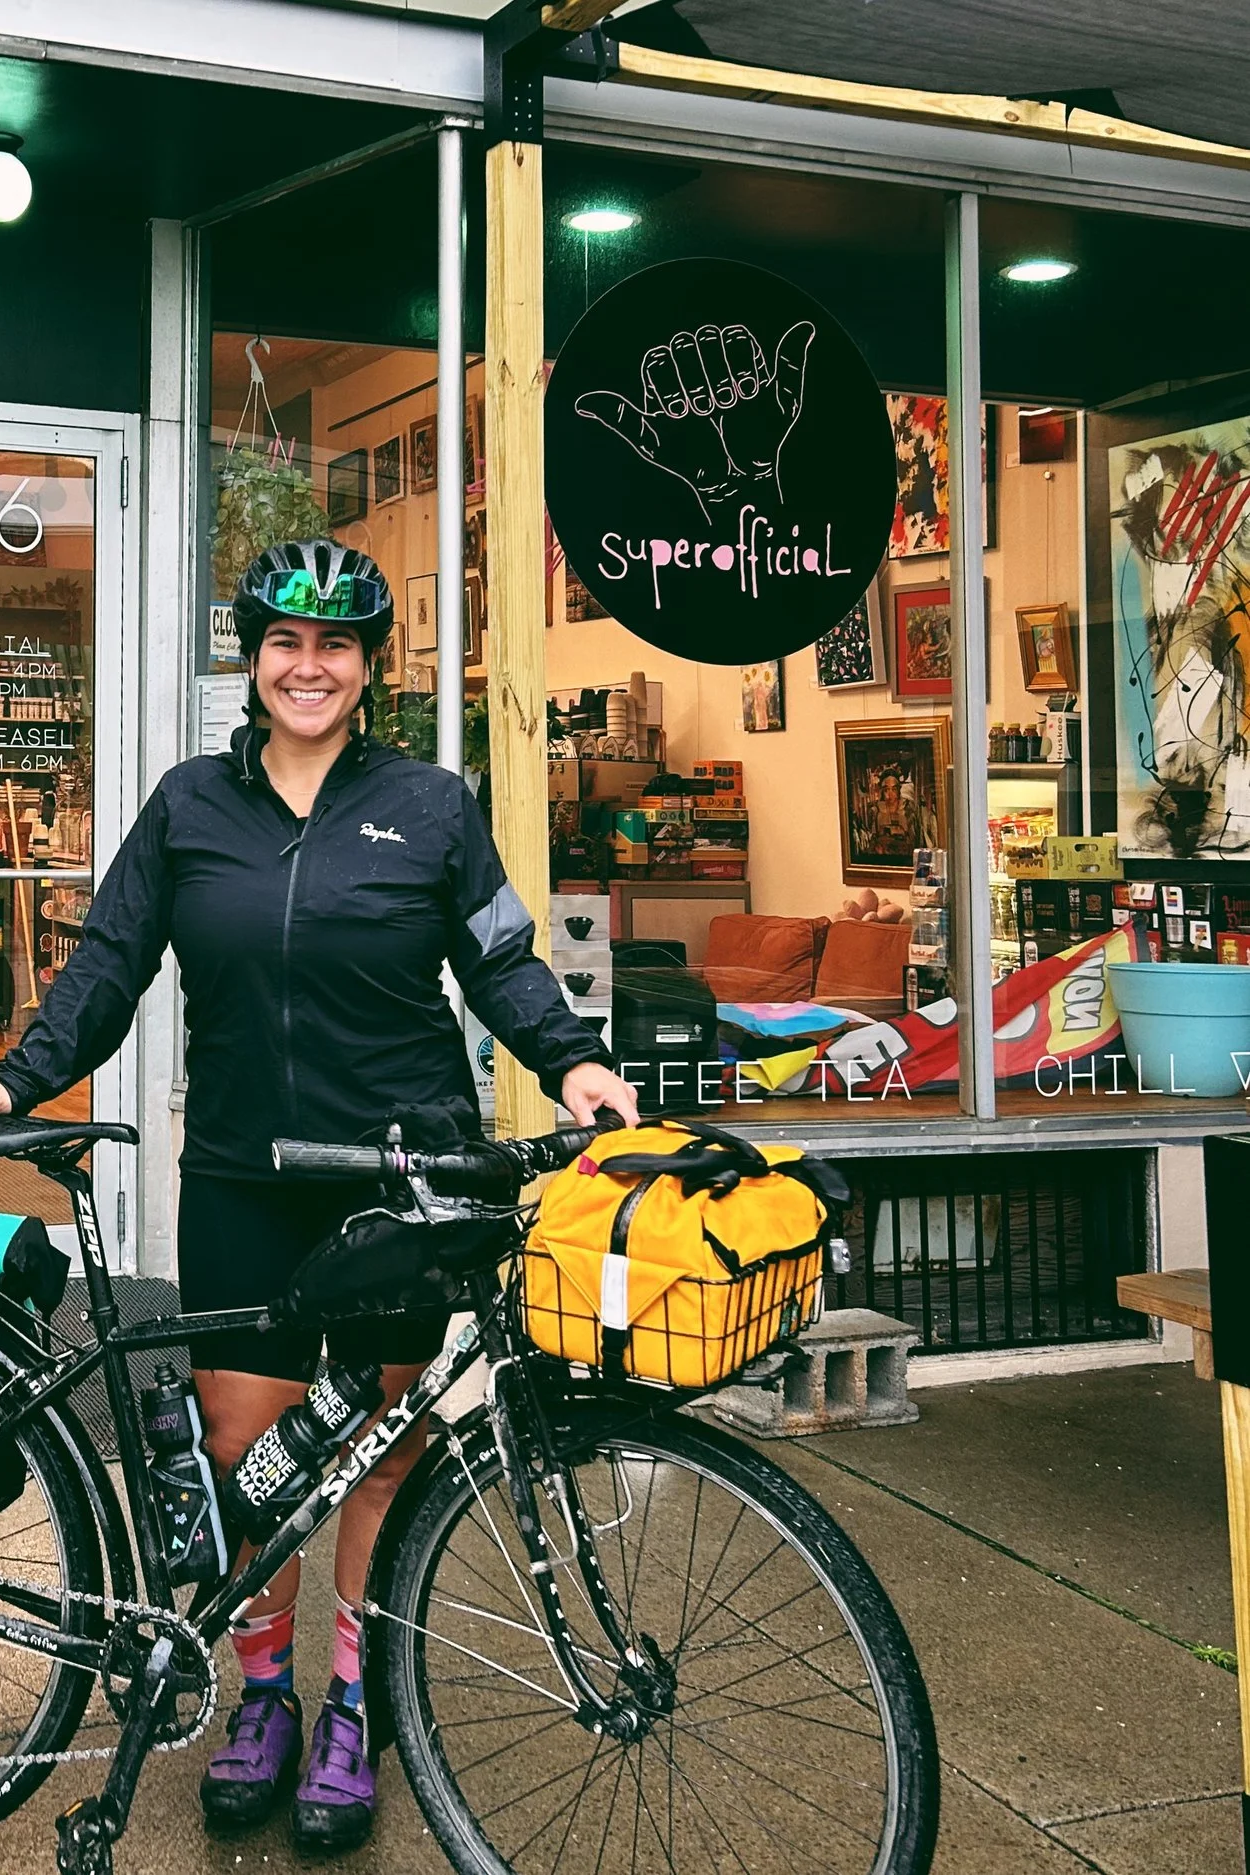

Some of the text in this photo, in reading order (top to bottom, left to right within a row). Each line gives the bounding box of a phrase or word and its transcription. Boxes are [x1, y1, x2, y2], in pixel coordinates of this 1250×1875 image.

[359, 822, 406, 842] Rapha
[620, 1058, 912, 1105] FFEE TEA
[1034, 1053, 1196, 1098] CHILL
[76, 1189, 103, 1268] ZIPP
